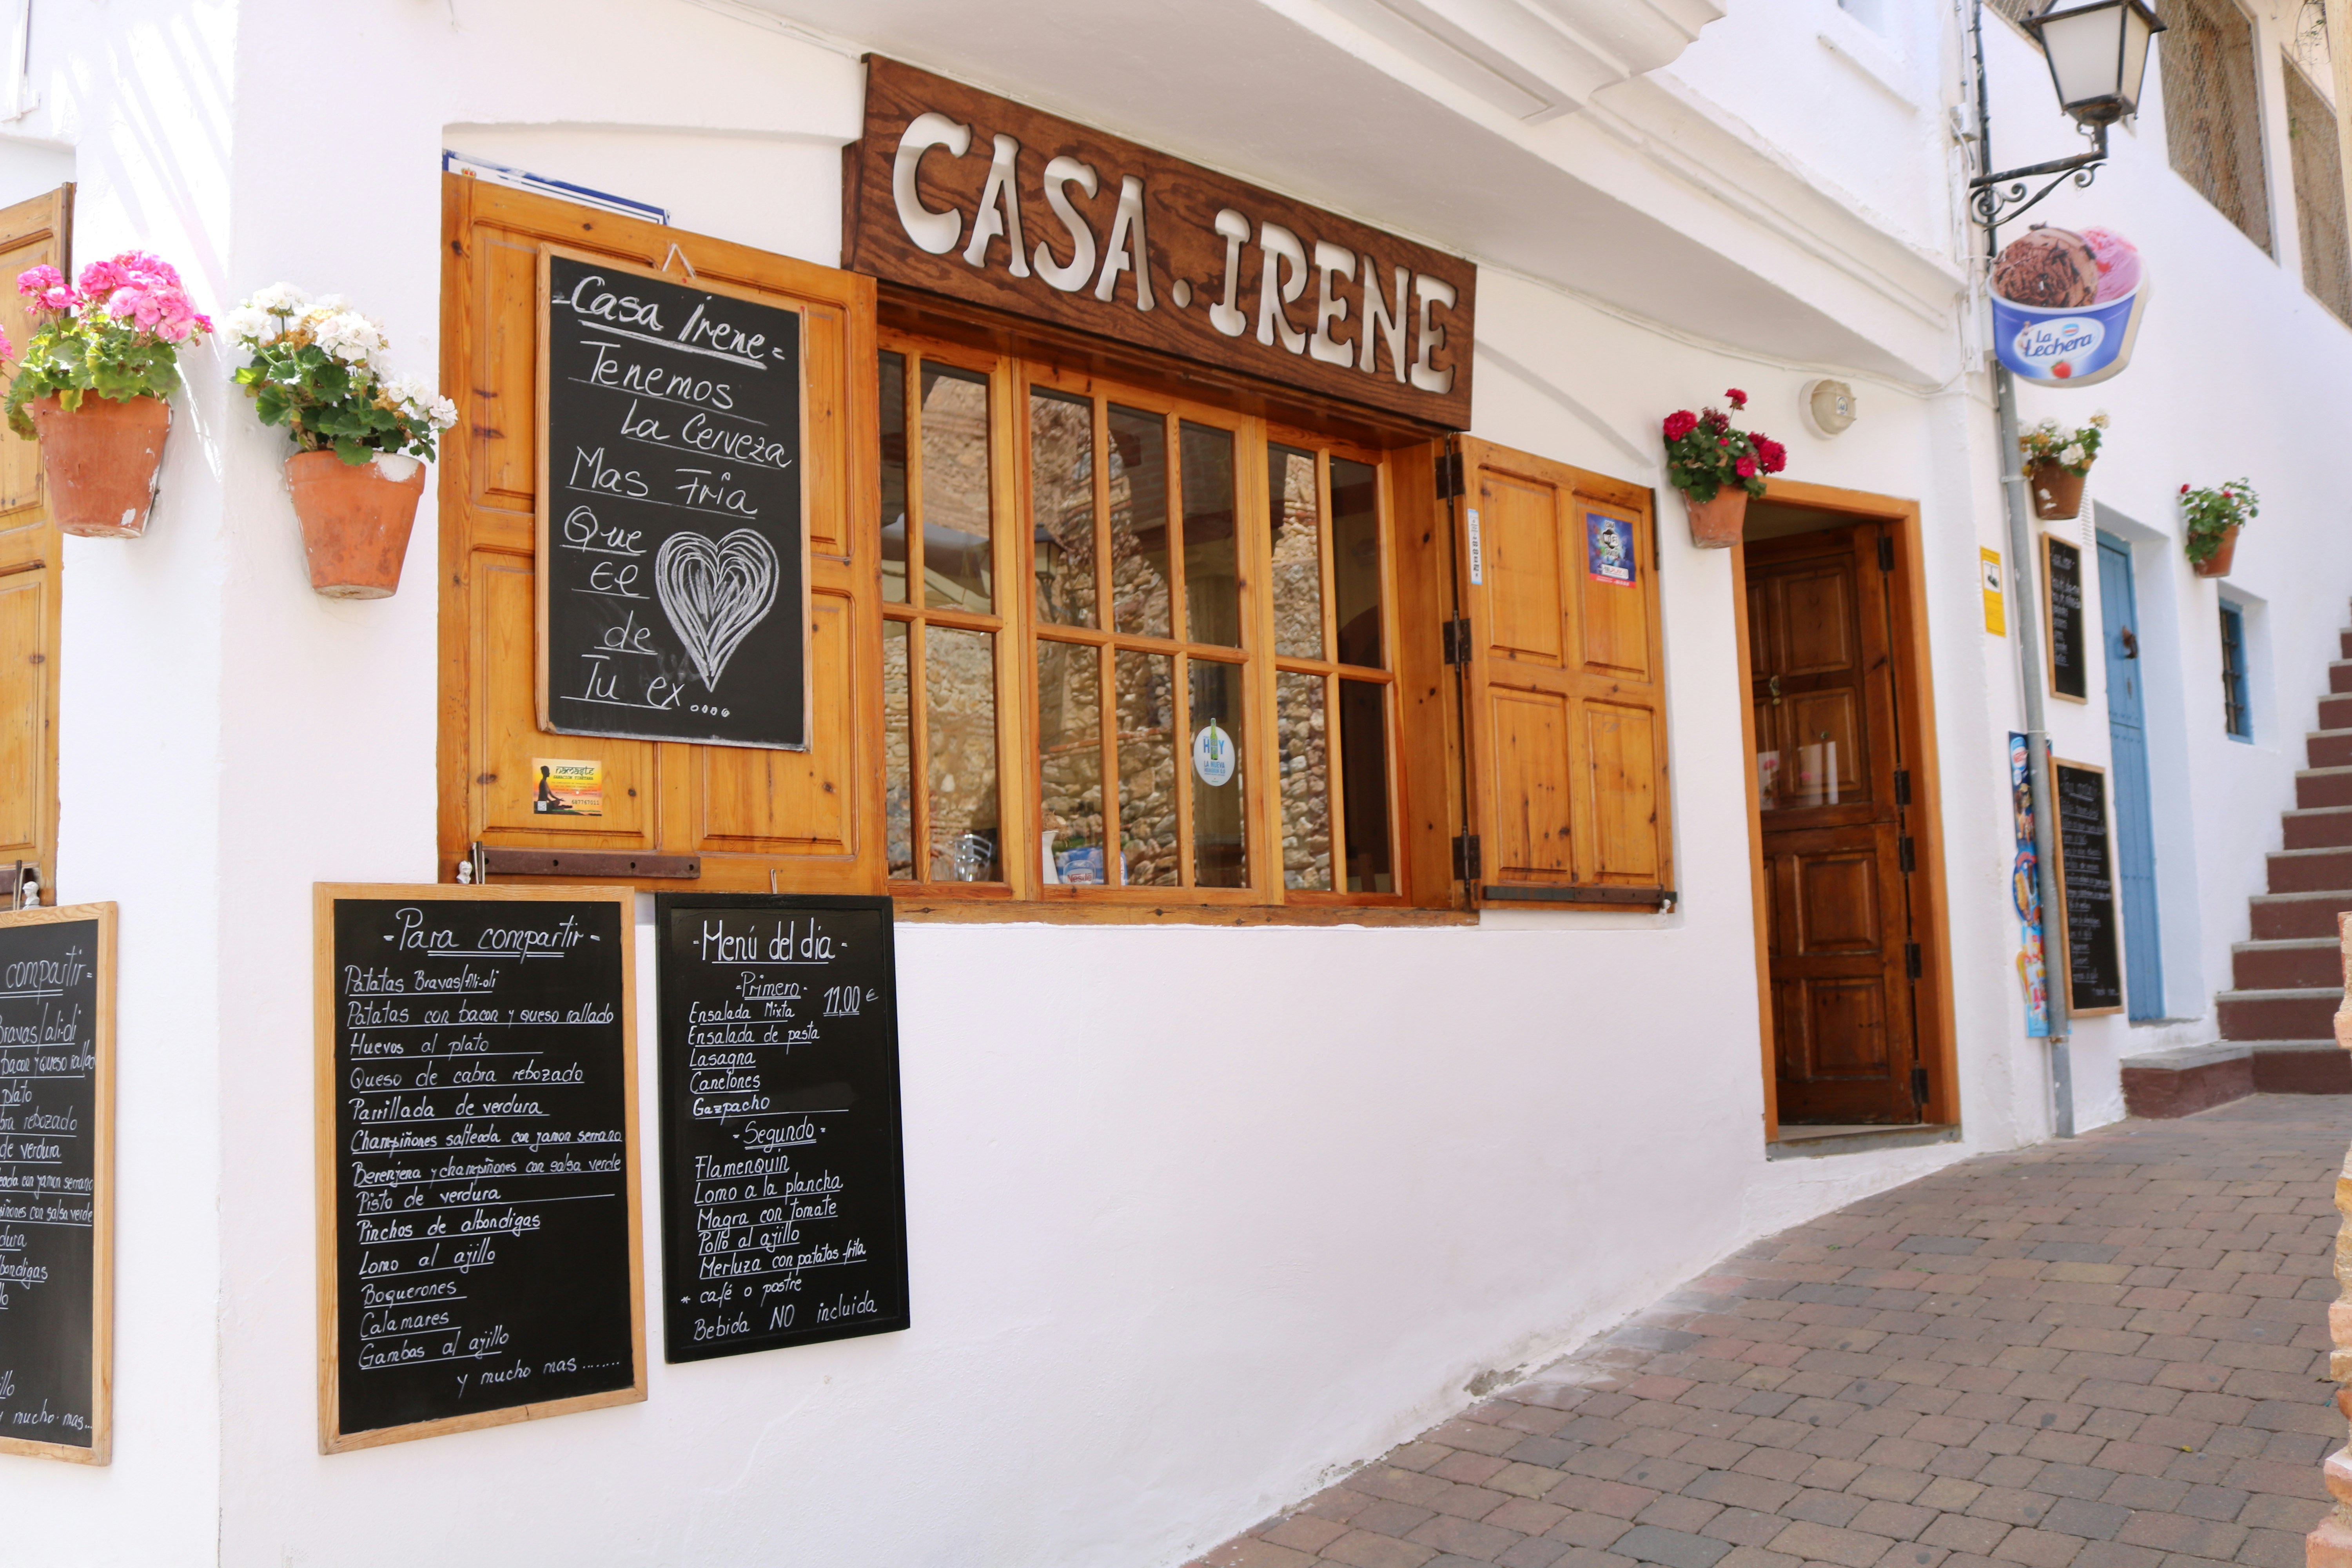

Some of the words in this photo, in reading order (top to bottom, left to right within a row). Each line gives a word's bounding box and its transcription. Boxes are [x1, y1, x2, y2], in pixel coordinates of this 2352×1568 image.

[1209, 207, 1457, 395] IRENE
[2025, 332, 2093, 357] Lechera
[2036, 330, 2052, 343] La
[580, 341, 733, 410] Tenemos
[621, 399, 671, 440] La
[682, 413, 792, 468] Cerveza
[569, 446, 648, 497] Mas
[564, 505, 647, 553] Que
[604, 610, 656, 652] de
[581, 654, 620, 700] Tu
[769, 921, 794, 960] del
[345, 964, 404, 995] Patatas
[347, 1000, 409, 1027] Patatas
[424, 1009, 449, 1024] con
[459, 999, 498, 1023] bacon
[508, 1010, 515, 1029] y
[566, 1002, 614, 1024] rallado
[689, 1001, 751, 1024] Ensalada
[764, 1000, 795, 1018] Mixta
[824, 985, 860, 1018] 11,00
[866, 988, 879, 1002] €
[350, 1033, 404, 1055] Huevos
[421, 1033, 438, 1054] al
[448, 1032, 489, 1060] plato
[688, 1023, 755, 1045] Ensalada
[764, 1024, 778, 1042] de
[786, 1020, 820, 1054] pasta
[1, 1049, 30, 1076] bacon
[350, 1067, 402, 1089] Queso
[416, 1060, 438, 1086] de
[453, 1061, 497, 1083] cabra
[512, 1059, 584, 1082] rebozado
[690, 1048, 756, 1073] Lasagna
[2, 1079, 32, 1112] plato
[348, 1096, 435, 1121] Parrillada
[456, 1093, 474, 1116] de
[483, 1093, 543, 1115] verdura
[693, 1094, 770, 1125] Gazpacho
[24, 1105, 77, 1131] rebozado
[0, 1135, 14, 1160] de
[20, 1137, 62, 1159] verdura
[350, 1129, 437, 1158] Champiñones
[511, 1132, 530, 1144] con
[577, 1129, 622, 1143] serrano
[22, 1175, 34, 1187] con
[439, 1156, 517, 1185] champiñones
[526, 1160, 544, 1174] con
[550, 1153, 581, 1173] salsa
[588, 1153, 621, 1172] verde
[356, 1189, 392, 1214] Pisto
[404, 1185, 424, 1207] de
[440, 1182, 501, 1204] verdura
[694, 1182, 737, 1205] Lomo
[745, 1185, 757, 1198] a
[763, 1175, 778, 1197] la
[785, 1170, 843, 1205] plancha
[30, 1206, 43, 1220] con
[47, 1199, 68, 1221] salsa
[71, 1202, 93, 1222] verde
[356, 1219, 413, 1243] Pinchos
[427, 1215, 446, 1236] de
[461, 1207, 541, 1237] albondigas
[697, 1208, 749, 1237] Magra
[760, 1209, 782, 1223] con
[791, 1194, 837, 1221] tomate
[699, 1231, 729, 1255] Pollo
[738, 1227, 753, 1248] al
[358, 1251, 399, 1276] Lomo
[419, 1242, 439, 1267] al
[699, 1252, 762, 1279] Merluza
[772, 1254, 794, 1269] con
[796, 1245, 838, 1276] patatas
[361, 1281, 457, 1308] Boquerones
[700, 1281, 732, 1308] café
[744, 1286, 752, 1297] o
[760, 1272, 802, 1307] postre
[360, 1310, 449, 1337] Calamares
[693, 1312, 750, 1341] Bebida
[769, 1304, 795, 1330] NO
[817, 1290, 877, 1323] incluida
[358, 1343, 425, 1368] Gambas
[442, 1331, 460, 1356] al
[481, 1359, 531, 1385] mucho
